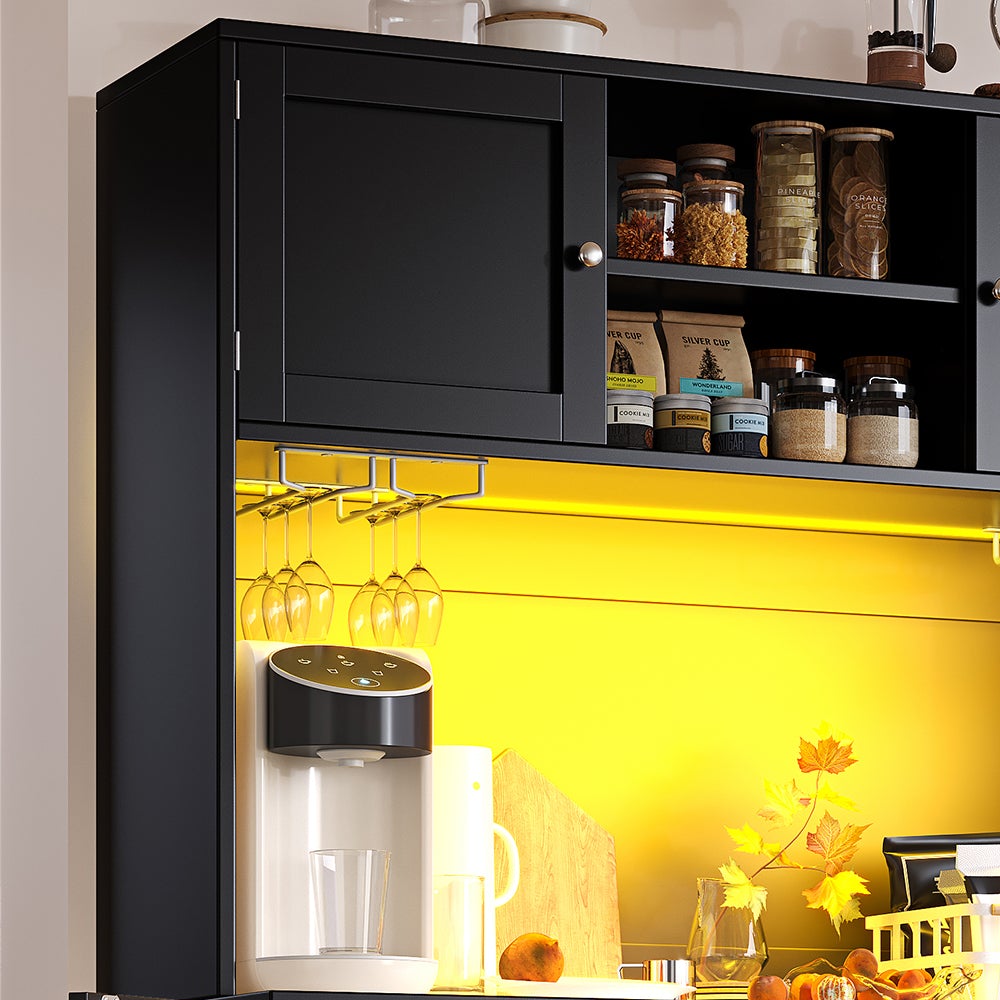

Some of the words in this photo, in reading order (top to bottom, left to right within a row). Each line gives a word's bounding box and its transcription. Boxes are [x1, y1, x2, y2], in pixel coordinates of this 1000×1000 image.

[625, 331, 642, 340] CUP
[681, 336, 712, 346] SILVER
[713, 338, 731, 347] CUP
[692, 382, 732, 390] WONDERLAND
